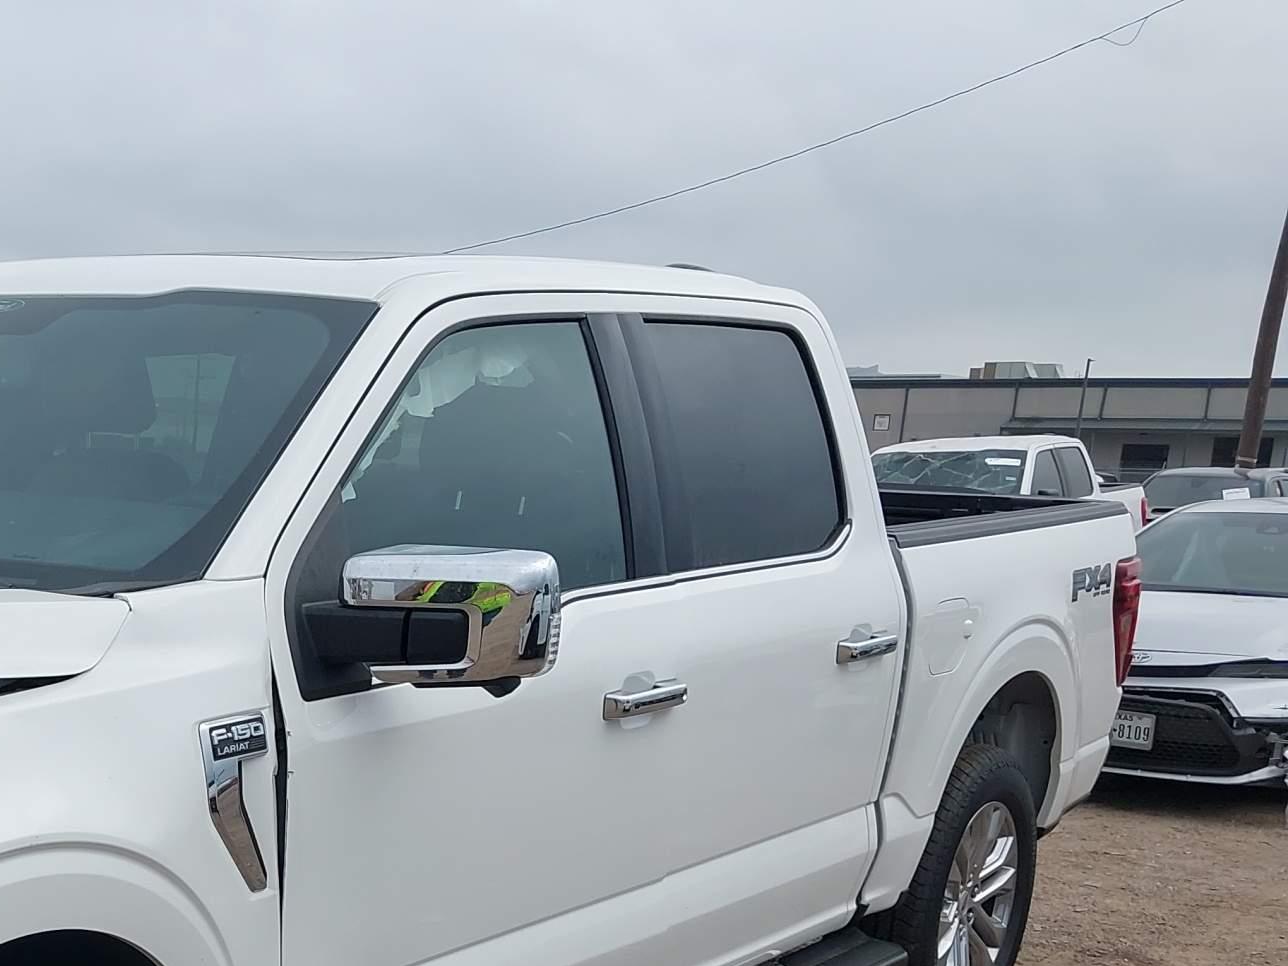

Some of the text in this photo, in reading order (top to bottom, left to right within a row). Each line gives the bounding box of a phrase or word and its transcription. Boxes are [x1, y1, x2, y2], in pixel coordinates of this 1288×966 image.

[1072, 562, 1112, 602] FX4
[1114, 711, 1133, 721] XAS
[211, 721, 264, 745] F-150
[1117, 723, 1150, 741] 8109
[217, 741, 250, 755] LARIAT
